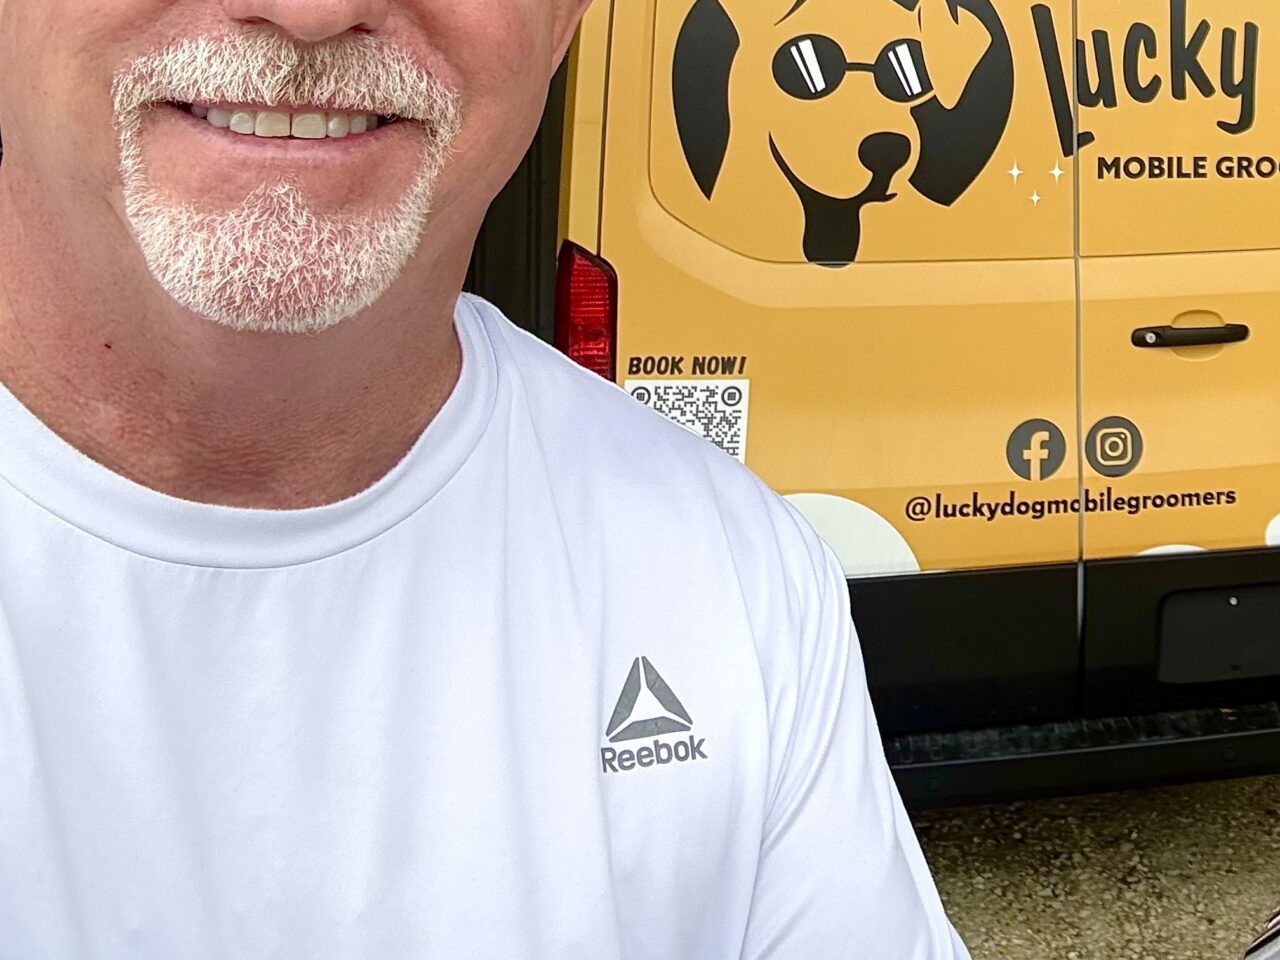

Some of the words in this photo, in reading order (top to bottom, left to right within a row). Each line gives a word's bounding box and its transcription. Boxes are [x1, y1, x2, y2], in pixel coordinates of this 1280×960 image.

[1096, 156, 1208, 180] MOBILE
[627, 356, 685, 376] BOOK
[691, 355, 748, 376] NOW!
[905, 487, 1237, 522] @luckydogmobilegroomers
[600, 735, 708, 774] Reebok
